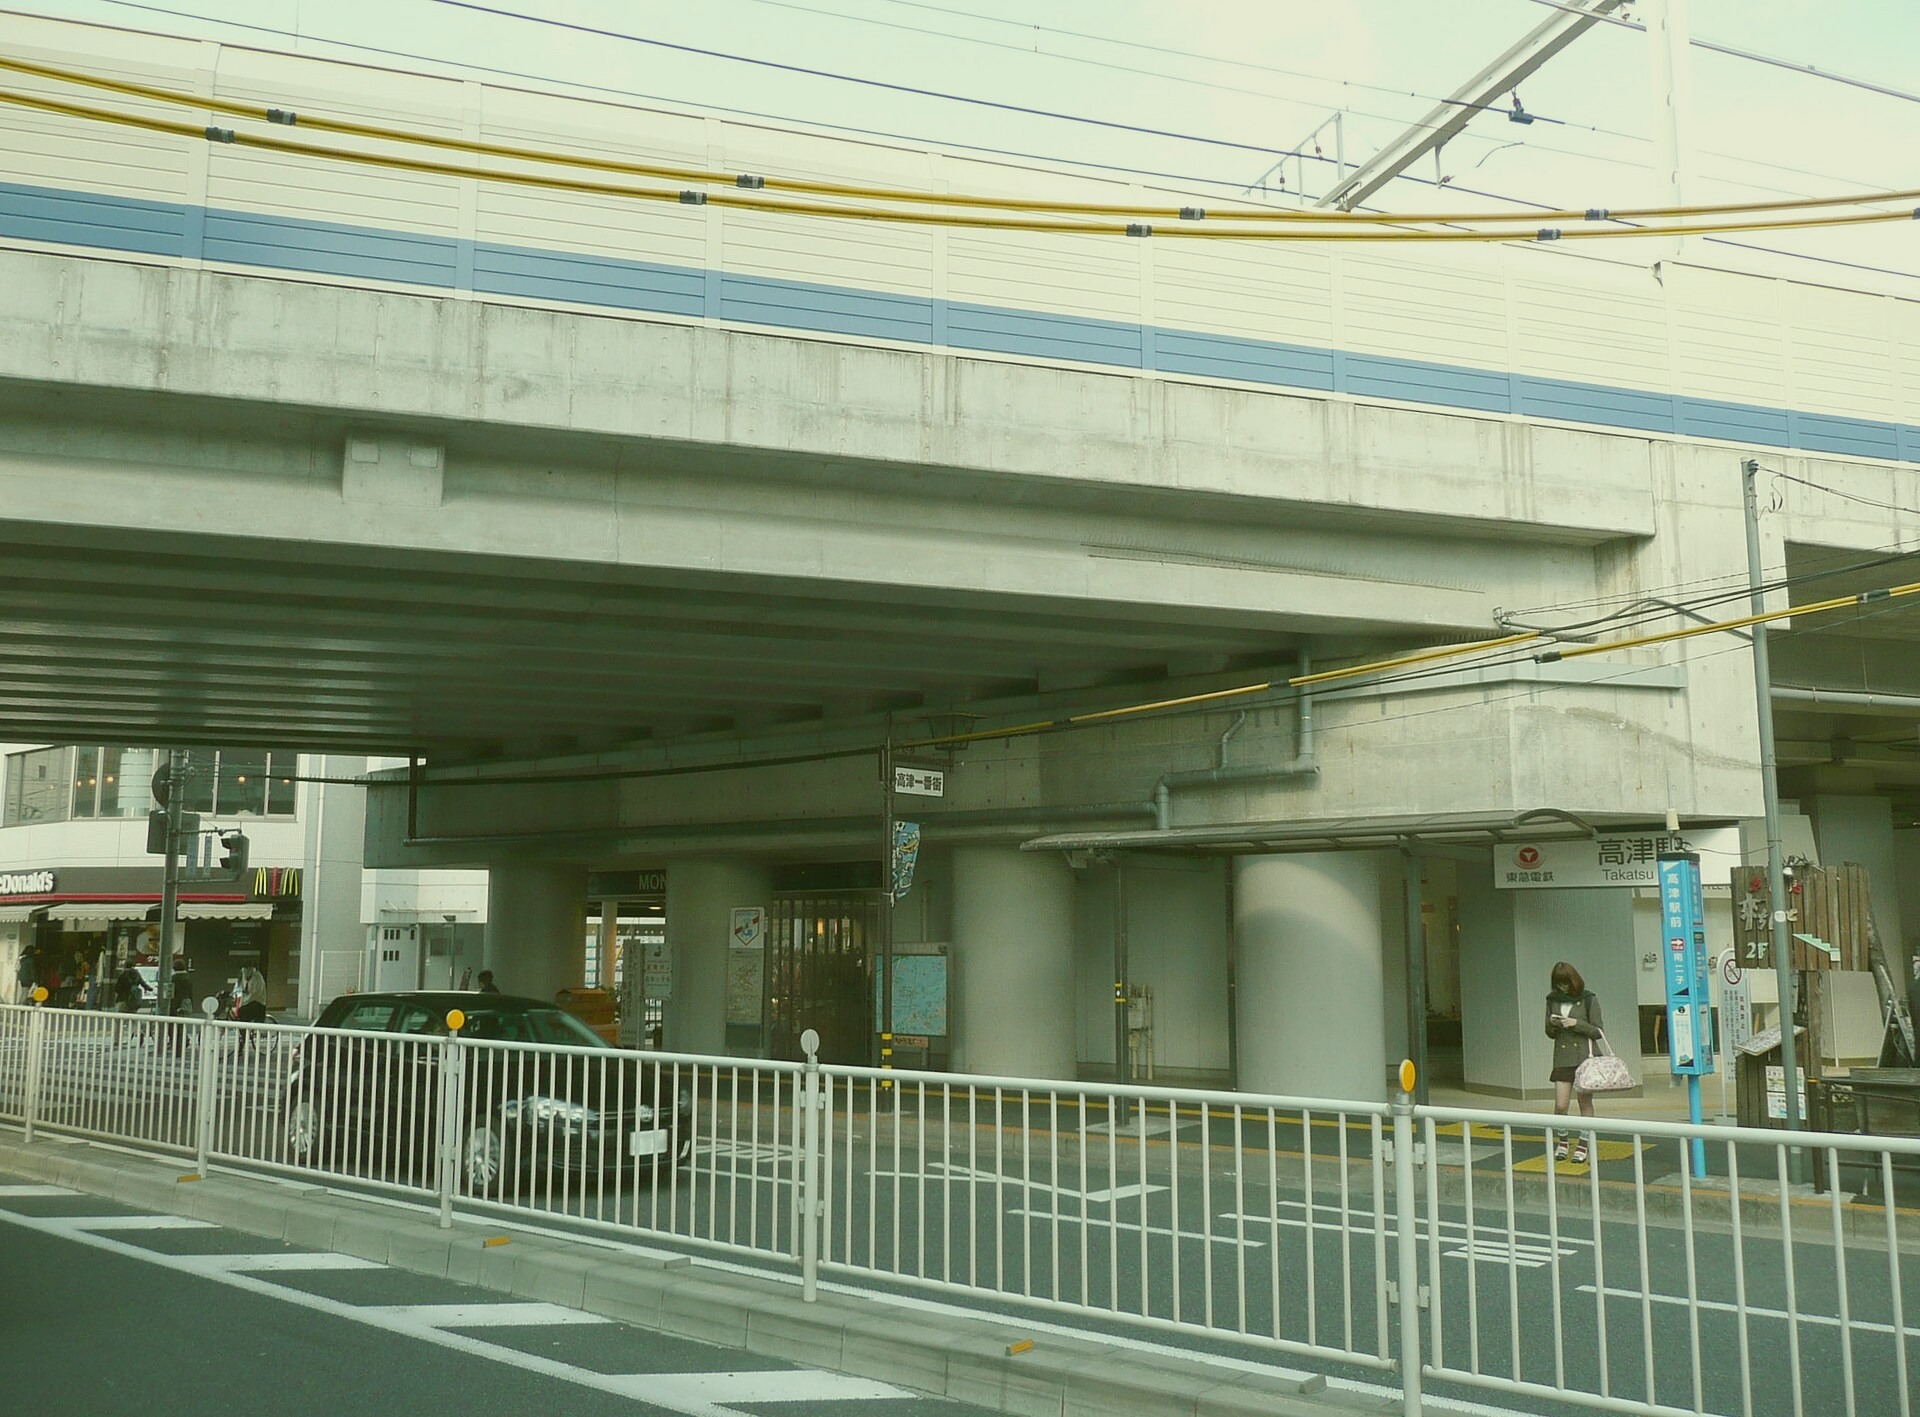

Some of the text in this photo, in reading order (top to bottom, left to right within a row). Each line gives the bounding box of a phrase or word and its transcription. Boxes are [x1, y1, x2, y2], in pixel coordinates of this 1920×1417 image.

[896, 772, 942, 792] 高津一番街
[0, 871, 54, 894] Donald's
[1506, 871, 1554, 883] 東急電鉄
[1602, 869, 1654, 881] Takatsu
[1667, 873, 1682, 928] 高津駅前
[1746, 942, 1769, 960] 2F
[1673, 953, 1684, 985] 南二子
